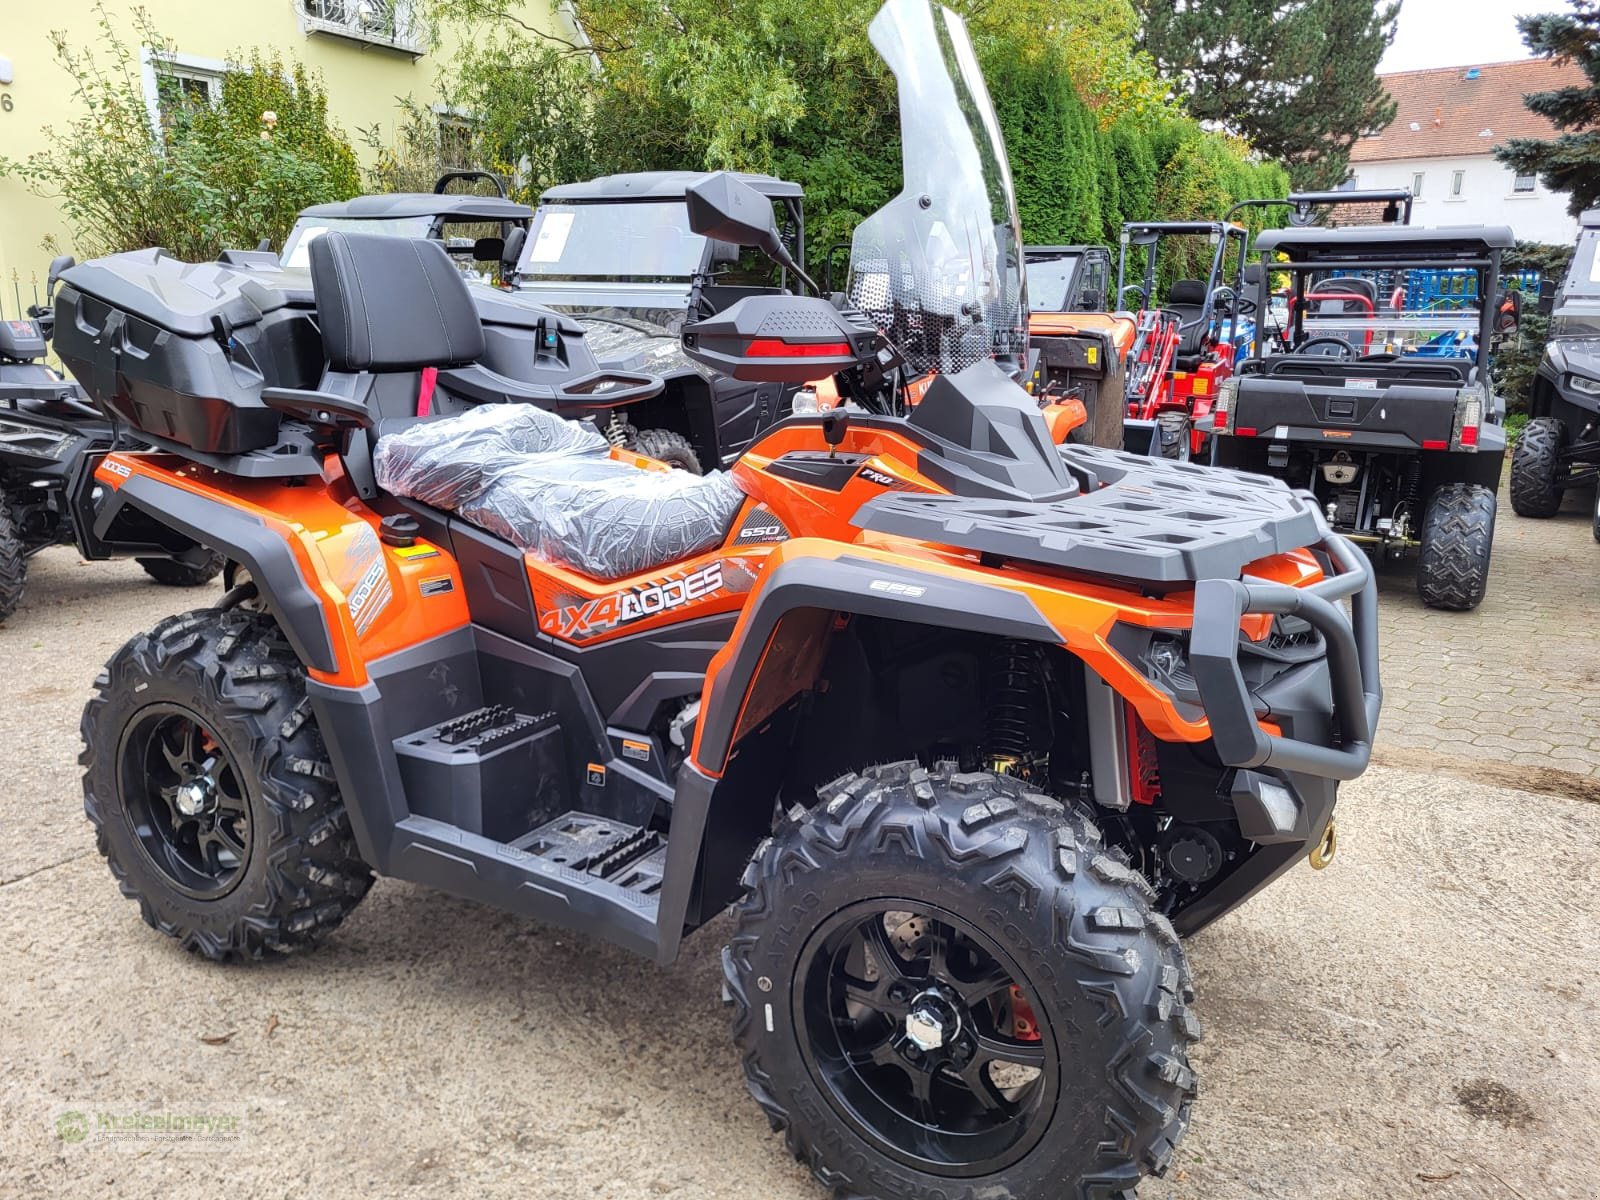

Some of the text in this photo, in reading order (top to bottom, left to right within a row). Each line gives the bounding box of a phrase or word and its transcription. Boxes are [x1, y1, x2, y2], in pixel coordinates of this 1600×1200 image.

[1, 93, 13, 112] 6
[860, 468, 893, 485] PRO
[740, 525, 780, 538] 650
[869, 580, 928, 598] EPS
[541, 594, 622, 637] 4X4
[620, 561, 724, 622] AODES
